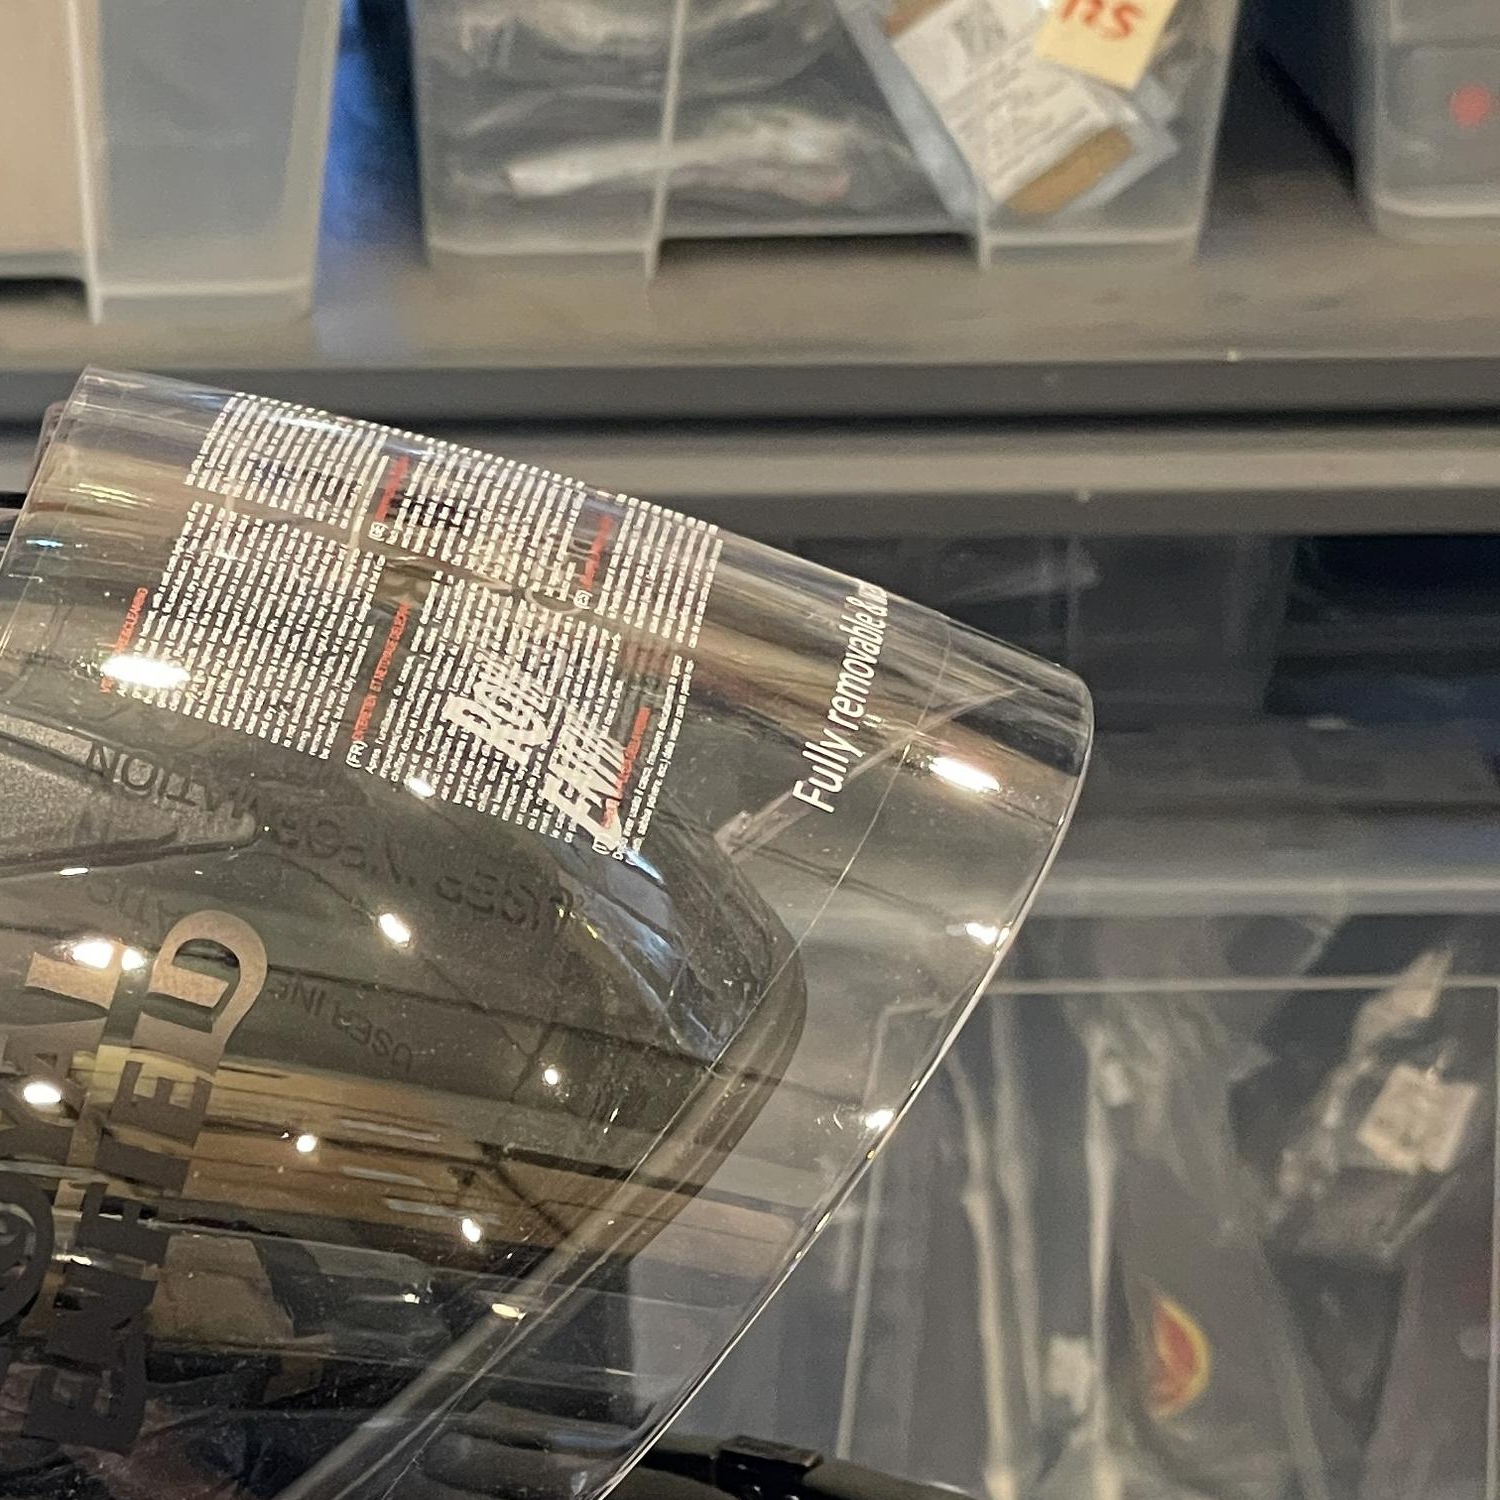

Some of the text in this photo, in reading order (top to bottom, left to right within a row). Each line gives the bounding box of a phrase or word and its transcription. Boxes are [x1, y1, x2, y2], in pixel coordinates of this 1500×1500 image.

[827, 614, 887, 731] removable
[344, 738, 368, 769] (FR)
[792, 728, 866, 813] Fully
[22, 910, 268, 1452] ENFIELD
